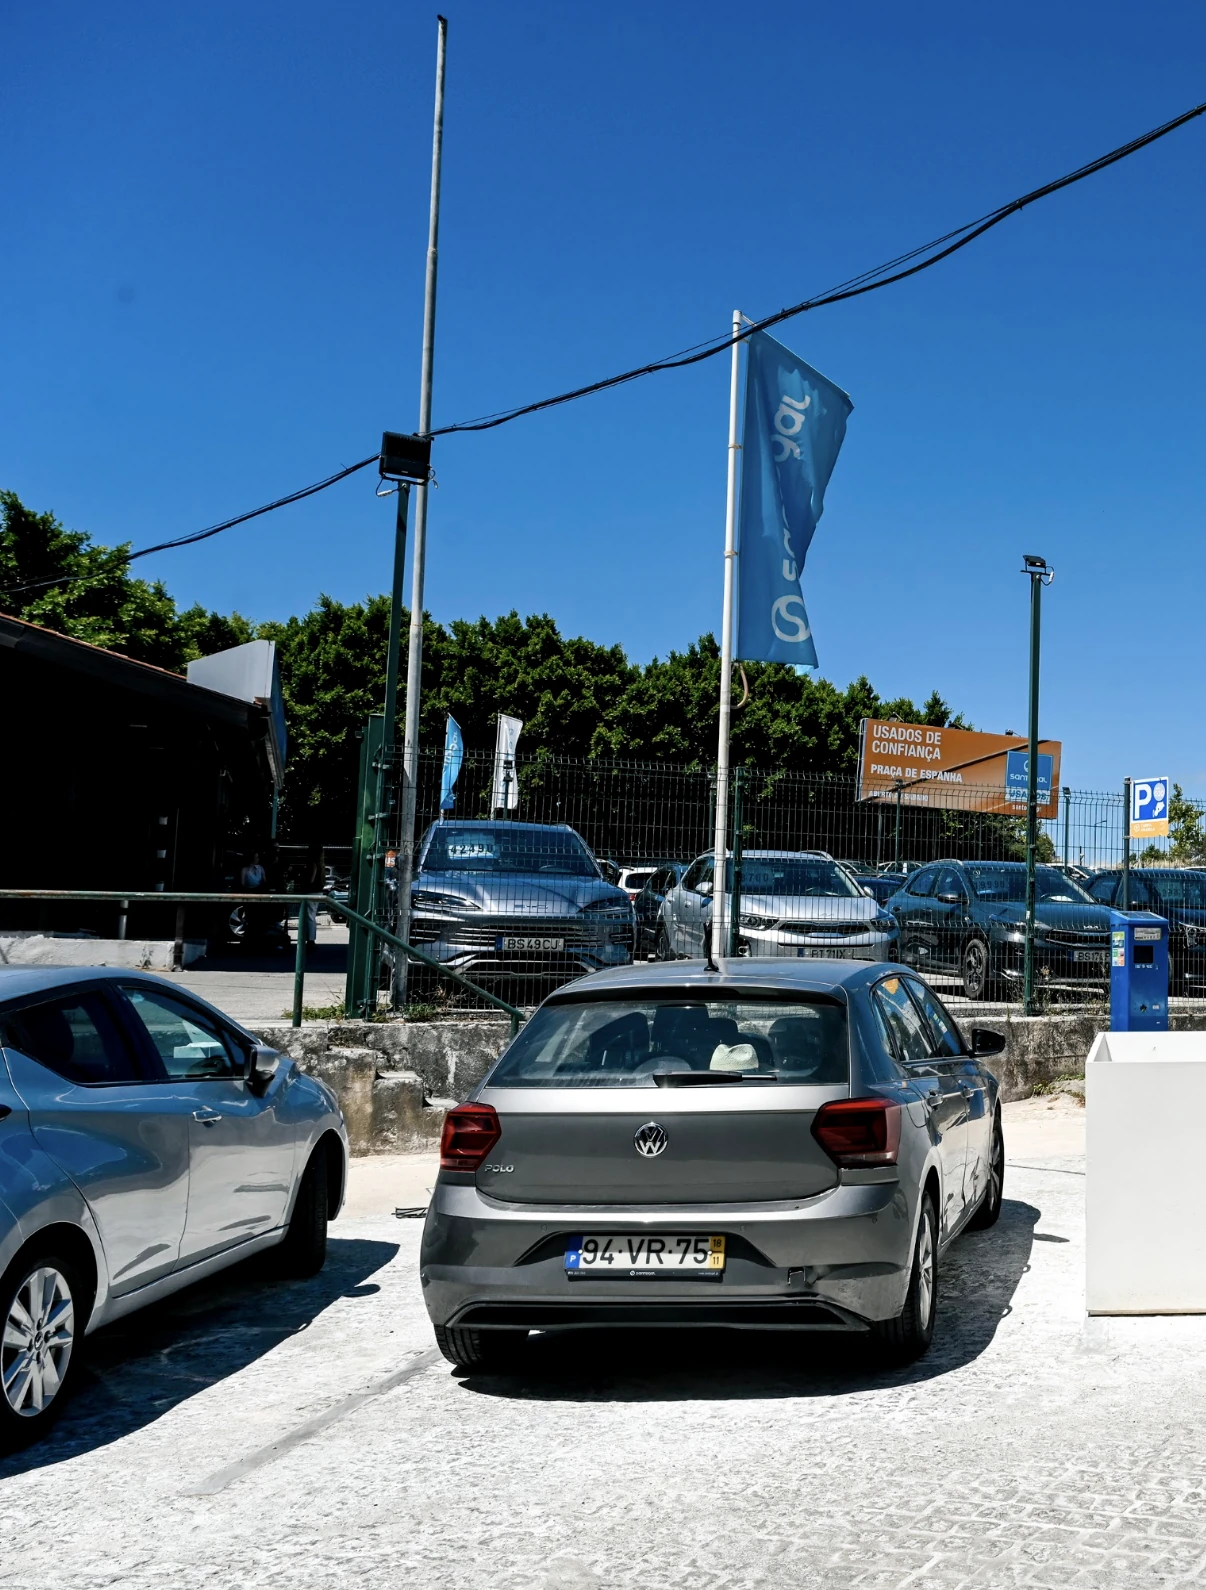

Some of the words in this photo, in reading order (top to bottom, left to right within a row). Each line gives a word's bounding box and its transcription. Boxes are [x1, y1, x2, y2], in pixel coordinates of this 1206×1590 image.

[873, 724, 923, 743] USADOS
[926, 732, 942, 745] DE
[871, 740, 941, 762] CONFIANÇA
[870, 764, 903, 779] PRAÇA
[905, 768, 918, 778] DE
[920, 769, 963, 783] ESPANHA
[1134, 783, 1152, 820] P
[484, 1164, 515, 1173] POLO
[713, 1239, 722, 1248] 18
[569, 1255, 577, 1263] P
[712, 1256, 720, 1265] 11
